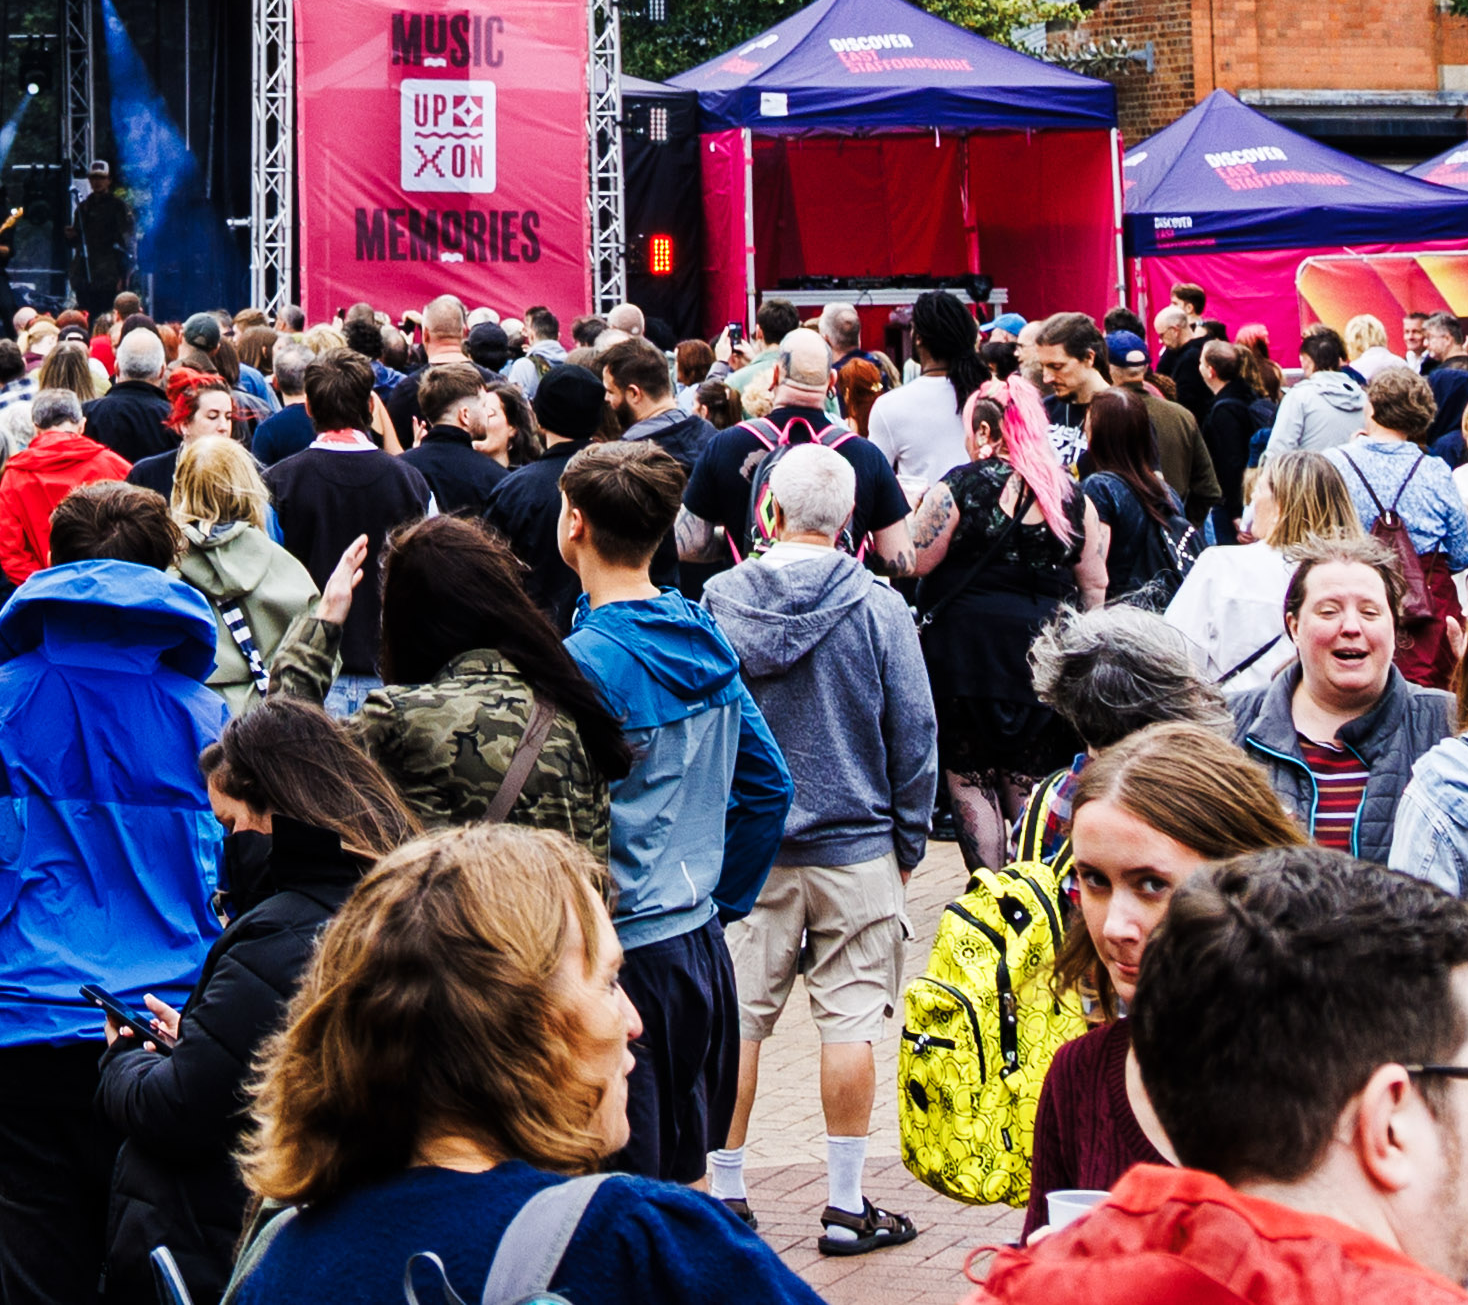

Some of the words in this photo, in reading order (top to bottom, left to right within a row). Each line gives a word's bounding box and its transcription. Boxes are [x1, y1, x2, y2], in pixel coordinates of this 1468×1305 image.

[392, 13, 504, 69] MUSIC
[829, 33, 914, 53] DISCOVER
[838, 50, 878, 69] EAST
[847, 57, 974, 74] STAFFORDSHIRE
[414, 94, 447, 127] UP
[452, 144, 483, 178] ON
[1204, 146, 1288, 168] DISCOVER
[1214, 163, 1257, 179] EAST
[1223, 170, 1351, 191] STAFFORDSHIRE
[1154, 216, 1192, 229] DISCOVER
[355, 208, 541, 263] MEMORIES
